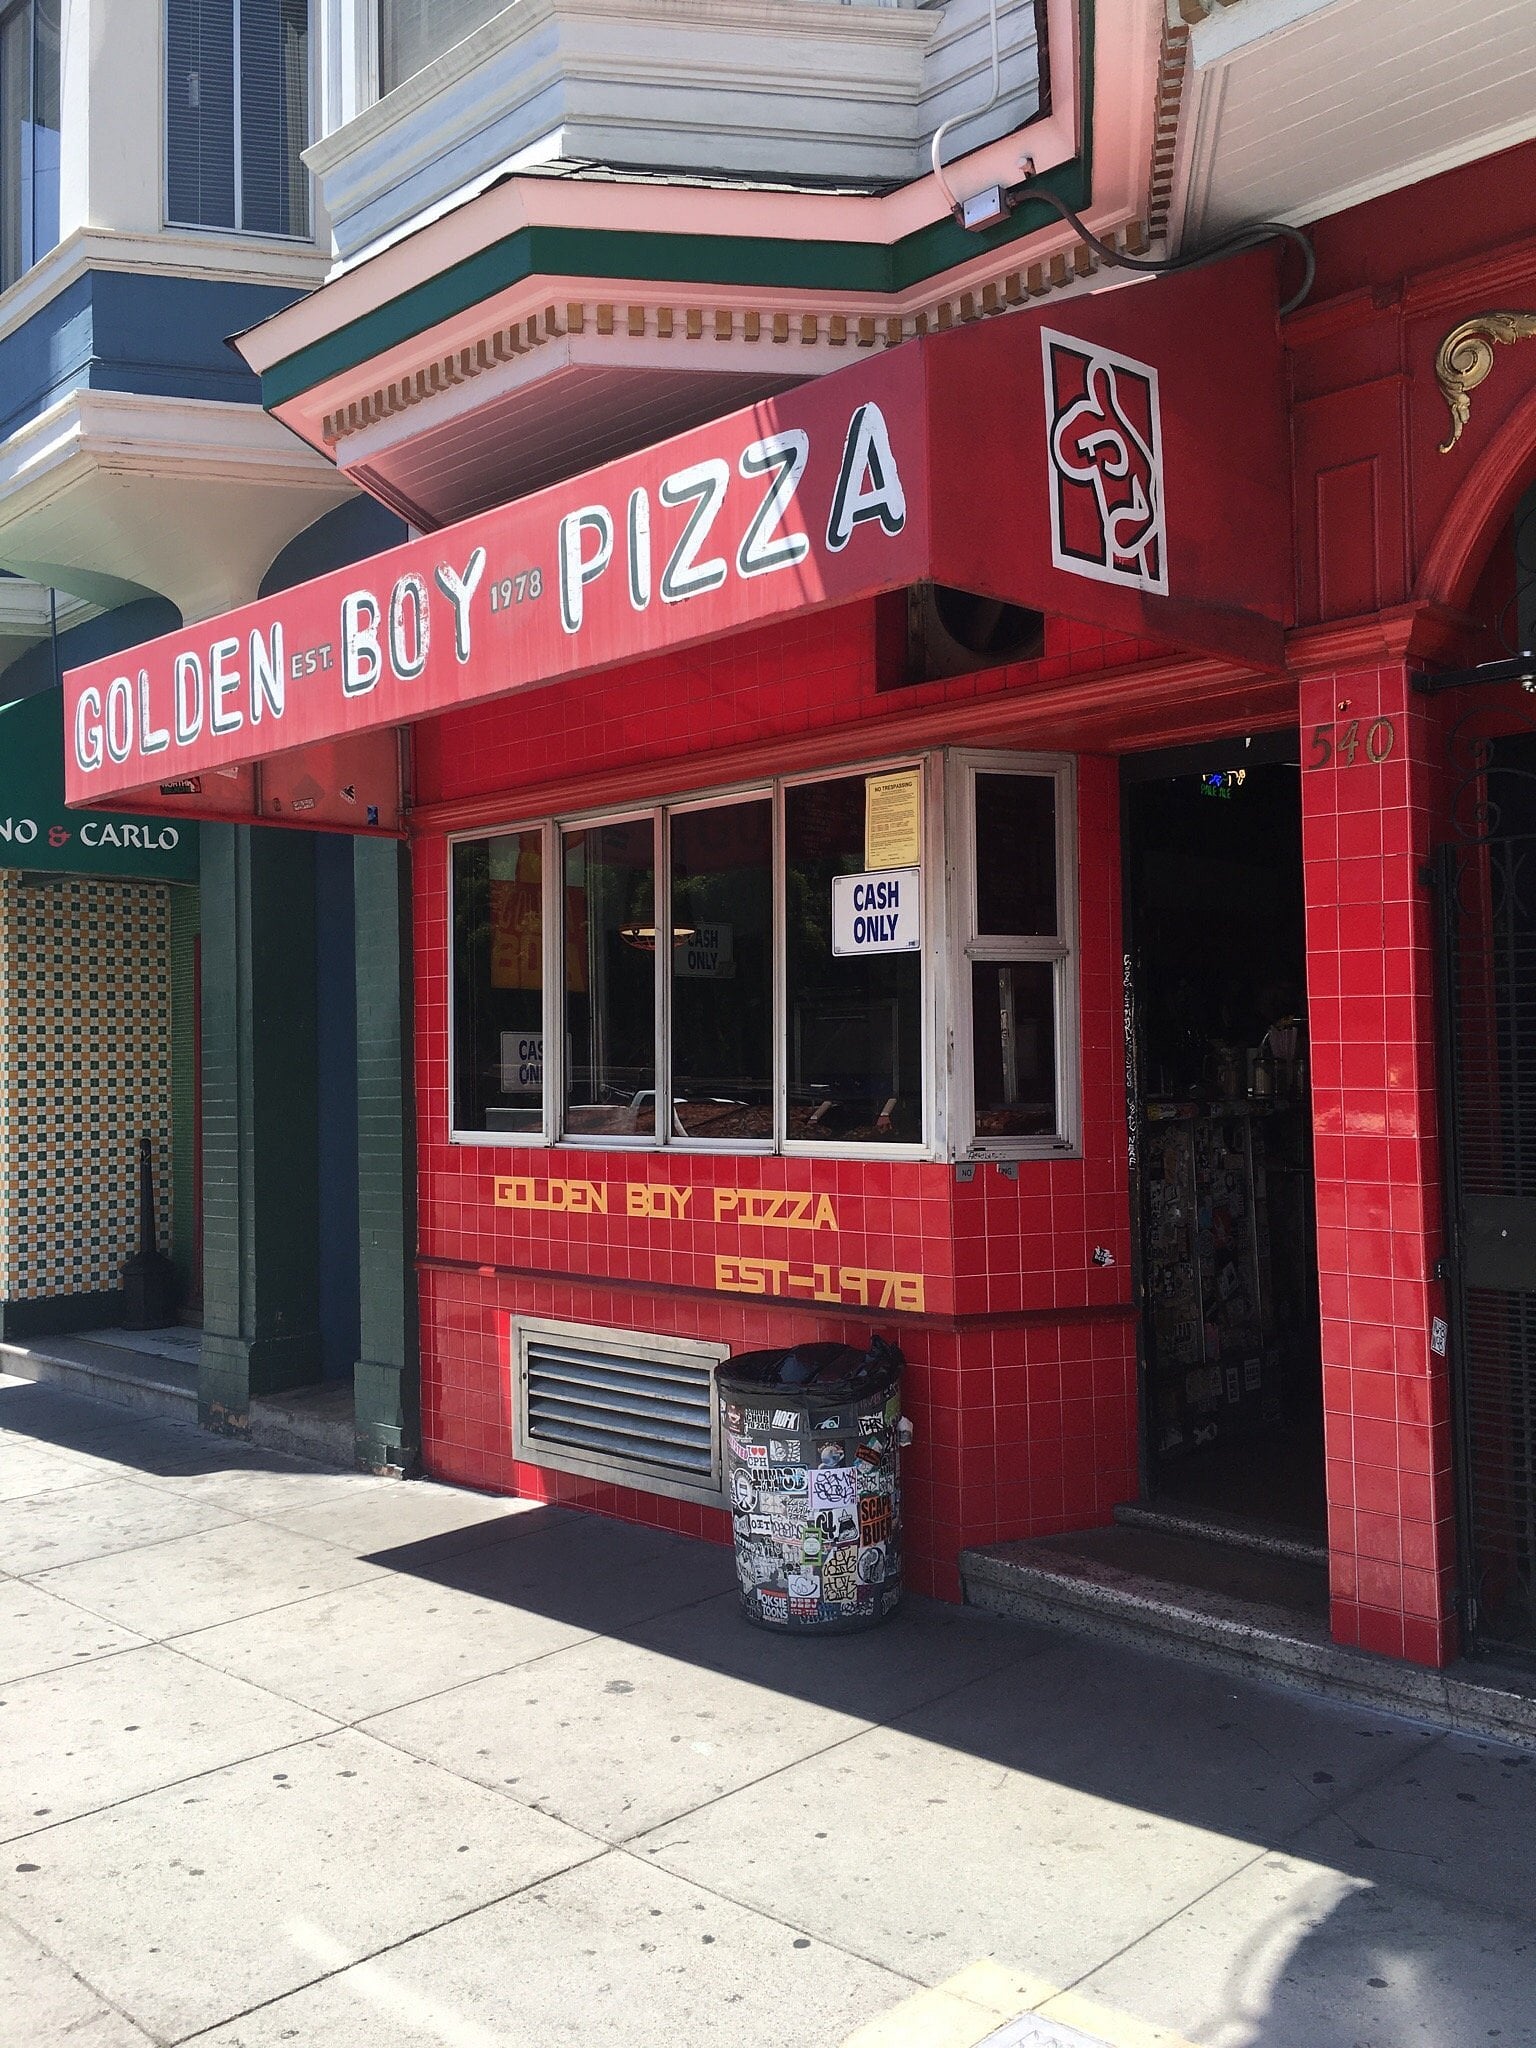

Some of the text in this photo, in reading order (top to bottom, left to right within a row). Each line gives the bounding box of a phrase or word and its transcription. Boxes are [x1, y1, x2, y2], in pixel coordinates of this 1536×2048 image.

[75, 401, 907, 772] GOLDEN EST. BOY 1978 PIZZA
[1309, 716, 1395, 770] 540
[882, 782, 913, 791] TRESPASSING
[47, 825, 72, 848] &
[80, 822, 179, 850] CARLO
[853, 880, 899, 911] CASH
[853, 914, 899, 944] ONLY
[687, 951, 718, 970] ONLY
[519, 1040, 543, 1061] CAS
[494, 1176, 839, 1231] GOLDEN BOY PIZZA
[762, 1605, 789, 1619] TOONS
